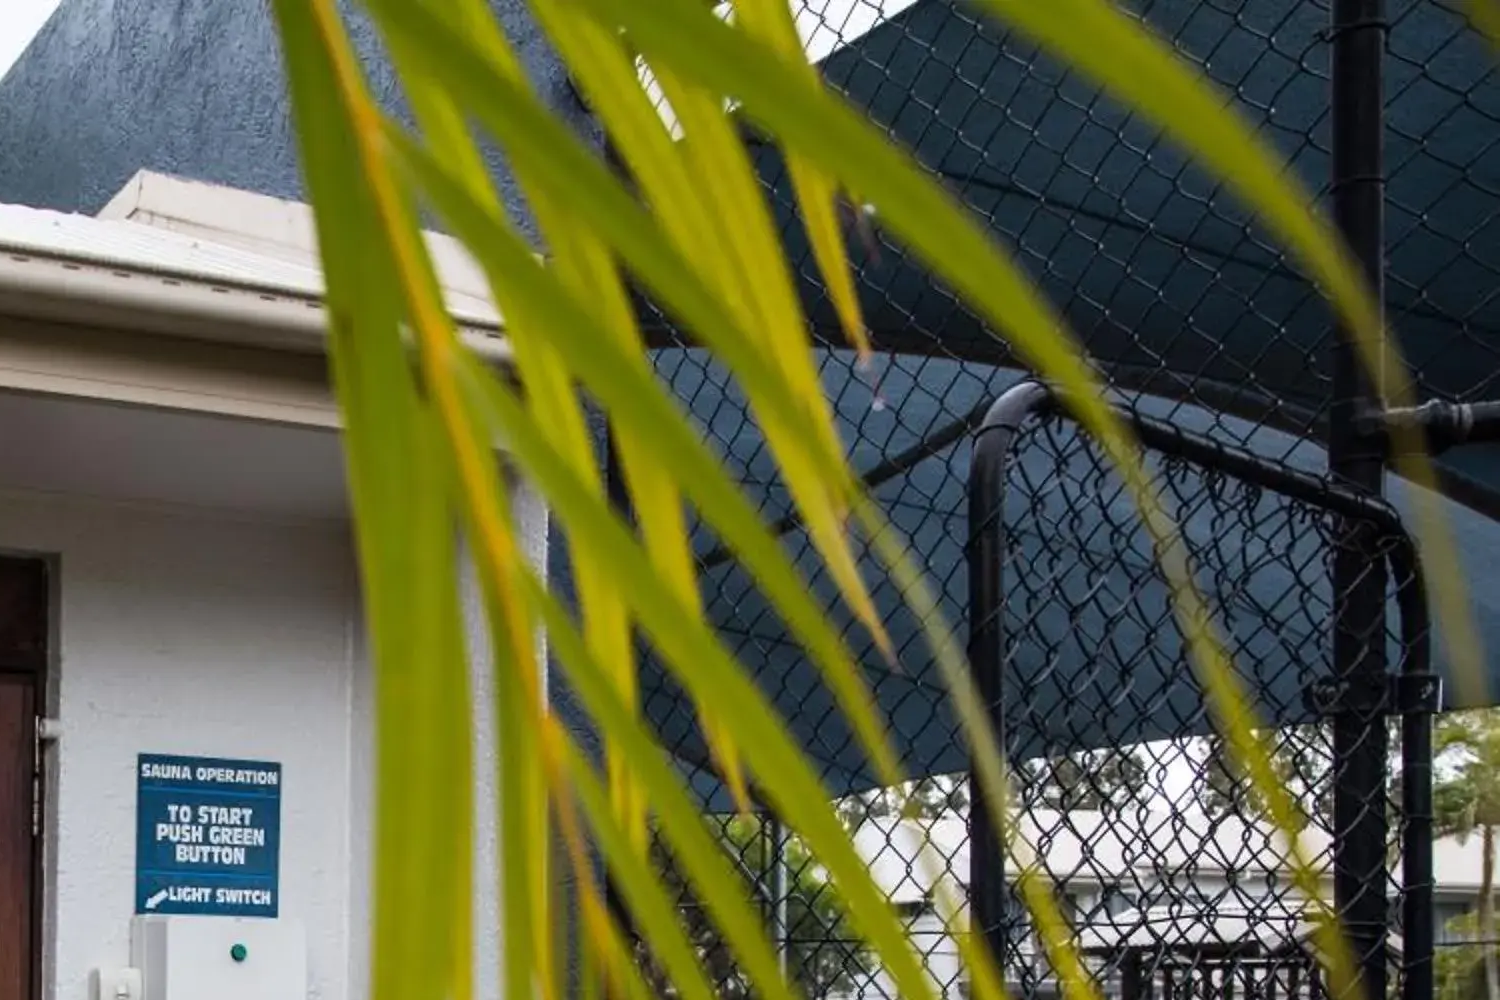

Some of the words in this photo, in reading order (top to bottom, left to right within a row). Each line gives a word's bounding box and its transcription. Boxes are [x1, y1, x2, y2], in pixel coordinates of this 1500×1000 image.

[142, 764, 192, 779] SAUNA
[196, 768, 277, 784] OPERATION
[168, 805, 191, 823] TO
[198, 806, 252, 825] START
[157, 823, 204, 842] PUSH
[208, 826, 264, 847] GREEN
[176, 844, 246, 864] BUTTON
[169, 887, 211, 902] LIGHT
[216, 889, 270, 904] SWITCH
